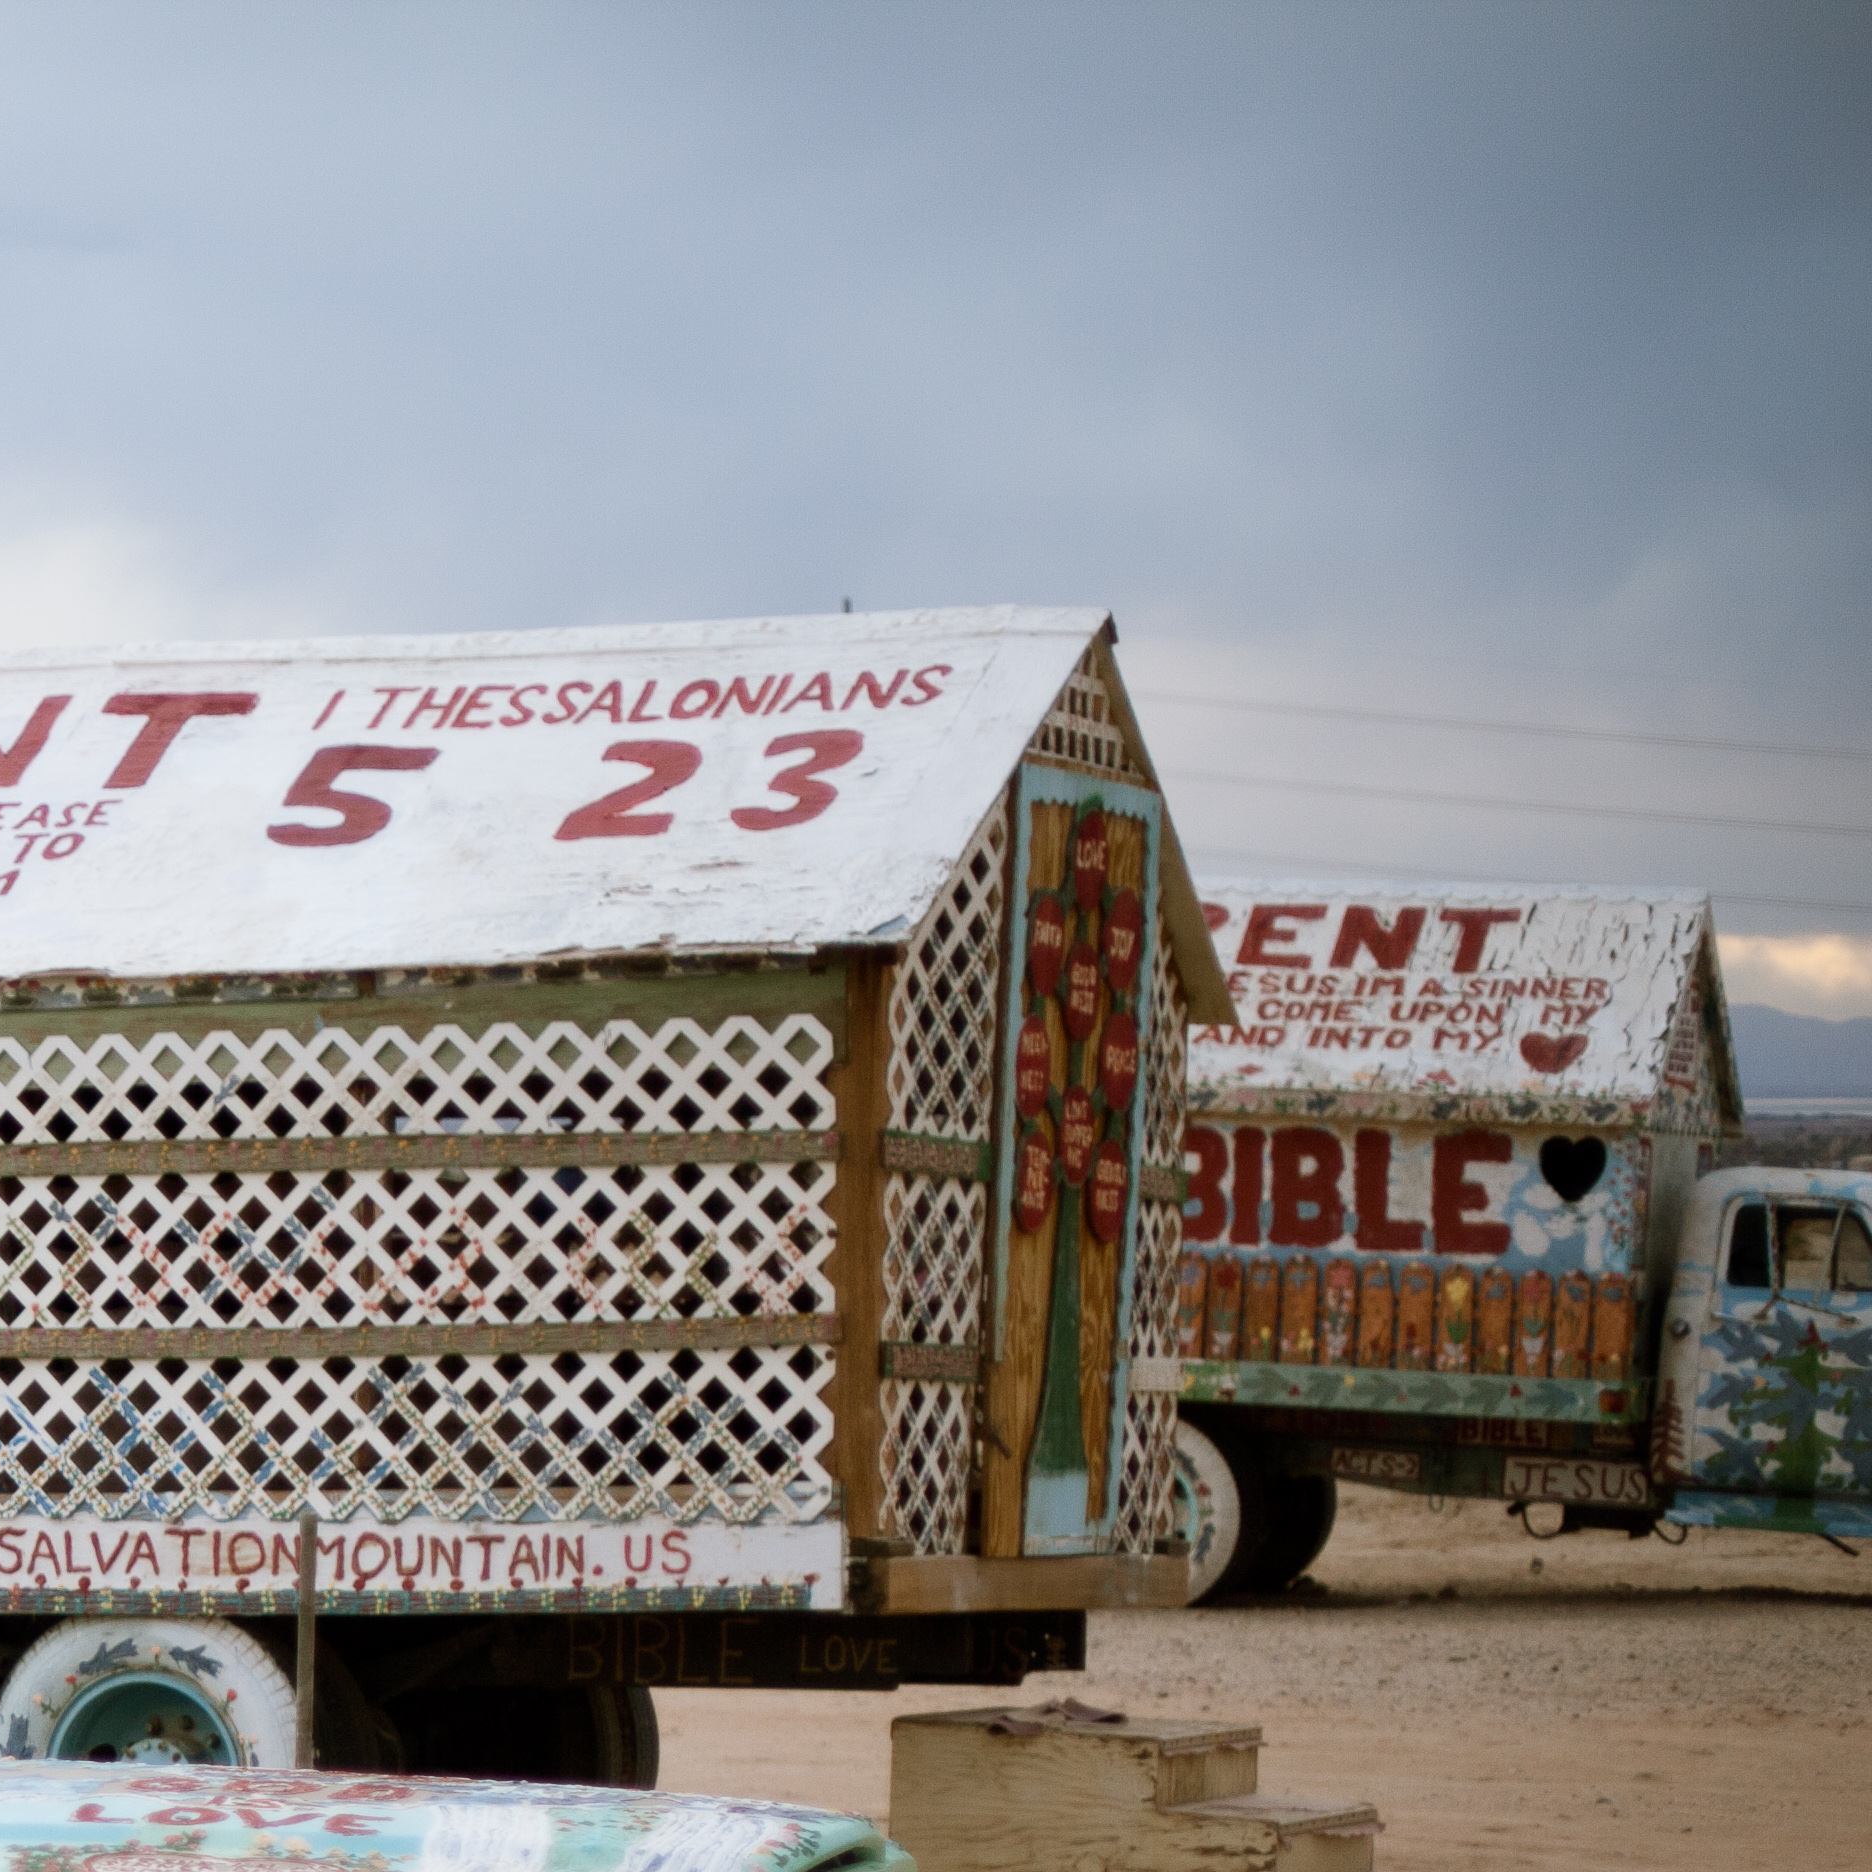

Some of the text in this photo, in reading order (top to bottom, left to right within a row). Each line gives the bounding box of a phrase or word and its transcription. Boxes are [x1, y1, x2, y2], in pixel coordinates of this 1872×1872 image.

[366, 664, 954, 730] THESSALONIANS
[266, 744, 441, 848] 5
[1075, 838, 1107, 871] LOVE
[1419, 977, 1446, 998] A
[1462, 977, 1610, 1000] SINNER
[1257, 998, 1599, 1026] COME UPON MY
[1192, 1024, 1286, 1048] AND
[1307, 1026, 1411, 1050] INTO
[1181, 1124, 1514, 1255] BIBLE
[1509, 1461, 1644, 1502] JESUS
[567, 1615, 760, 1685] BIBLE
[798, 1633, 901, 1674] LOVE
[128, 1774, 414, 1802] GOD
[69, 1801, 395, 1837] LOVE
